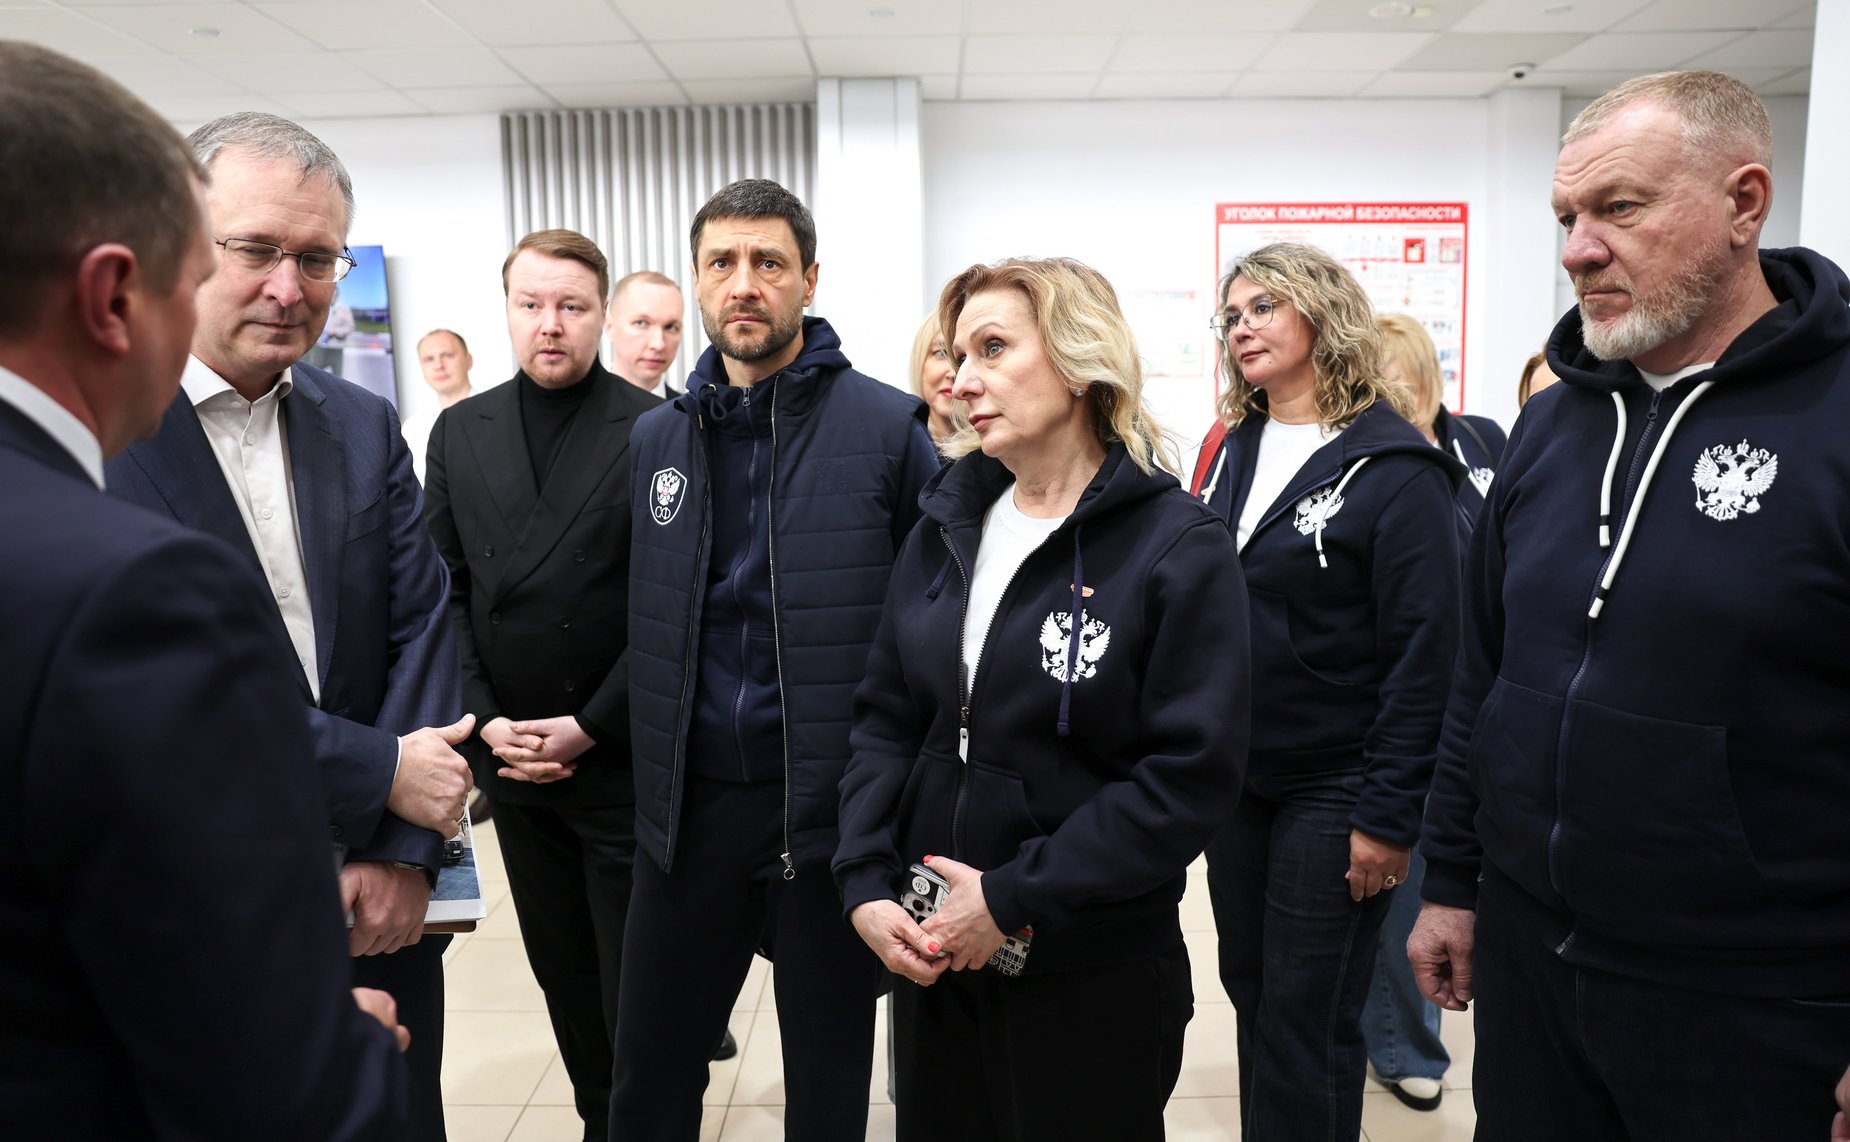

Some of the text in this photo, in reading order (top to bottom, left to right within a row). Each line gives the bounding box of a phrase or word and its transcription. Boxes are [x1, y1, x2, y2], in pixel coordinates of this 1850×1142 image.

[1223, 204, 1461, 221] УГОЛОК ПОЖАРНОЙ БЕЗОПАСНОСТИ
[655, 506, 671, 520] СФ
